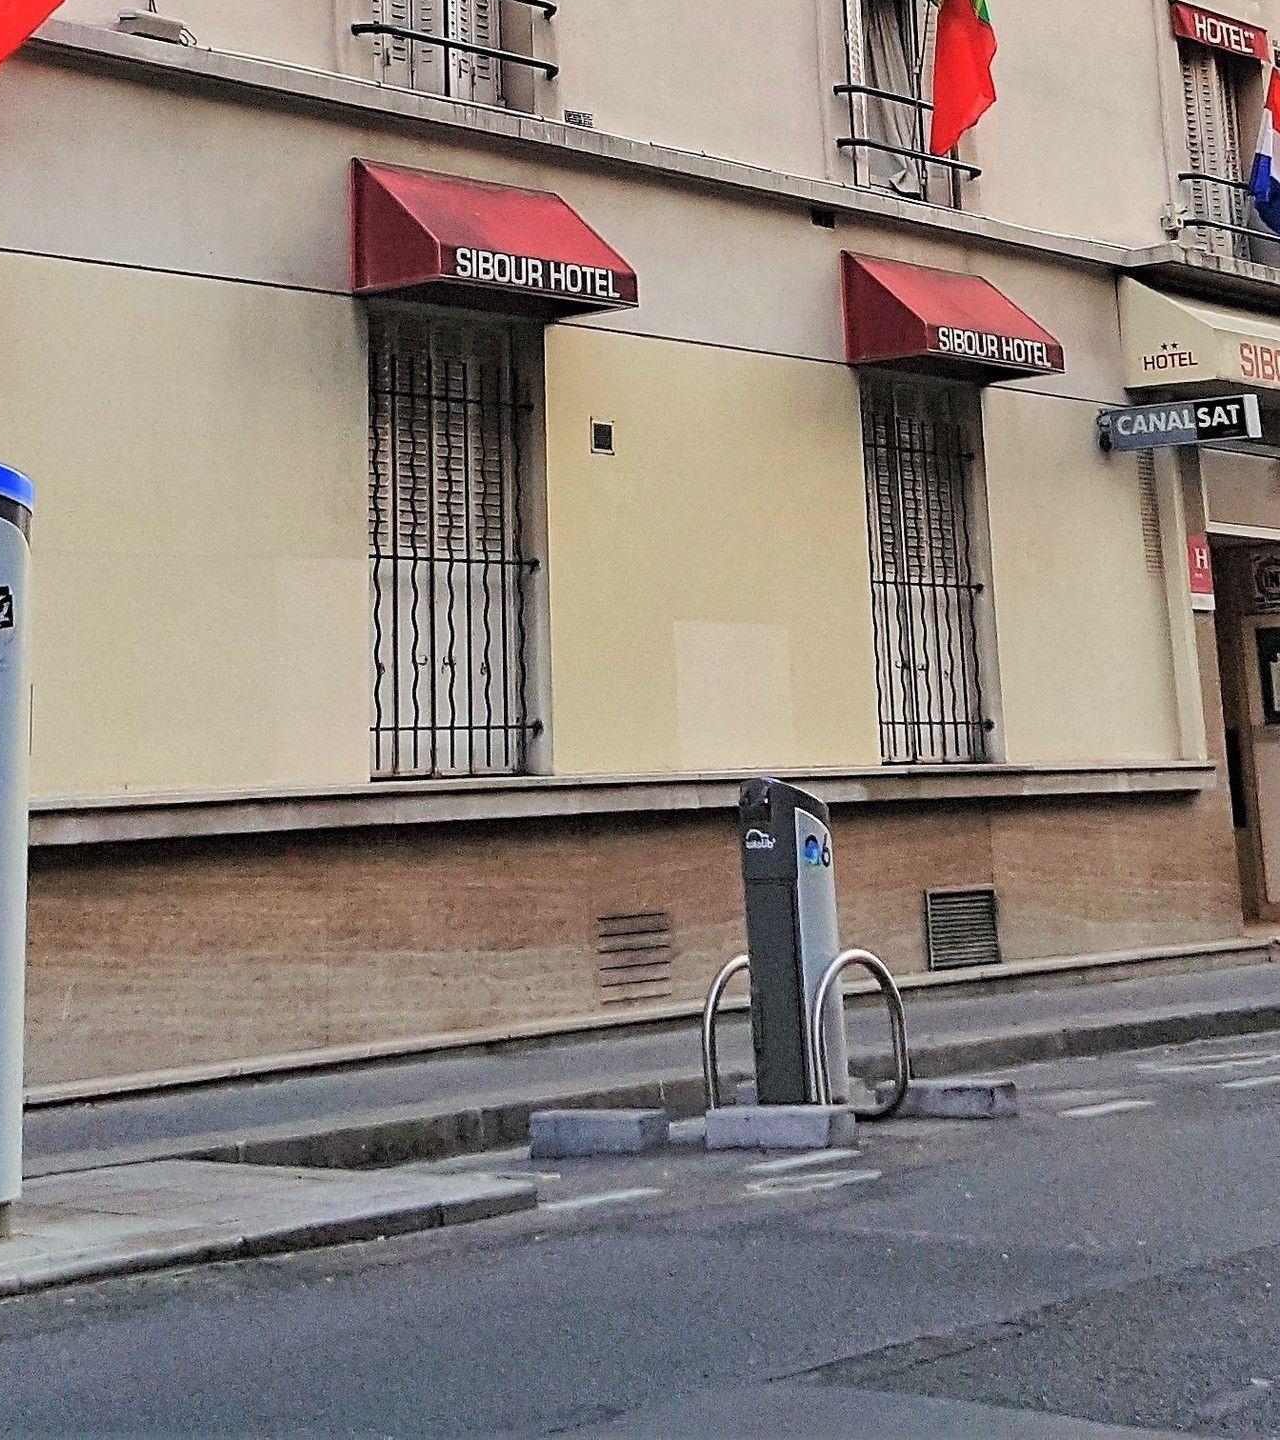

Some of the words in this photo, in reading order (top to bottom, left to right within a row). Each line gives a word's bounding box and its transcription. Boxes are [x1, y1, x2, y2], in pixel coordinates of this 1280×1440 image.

[1193, 12, 1254, 53] HOTEL
[456, 247, 543, 288] SIBOUR
[550, 261, 620, 298] HOTEL
[938, 326, 999, 358] SIBOUR
[1001, 337, 1051, 367] HOTEL
[1143, 351, 1198, 371] HOTEL
[1194, 547, 1209, 569] H
